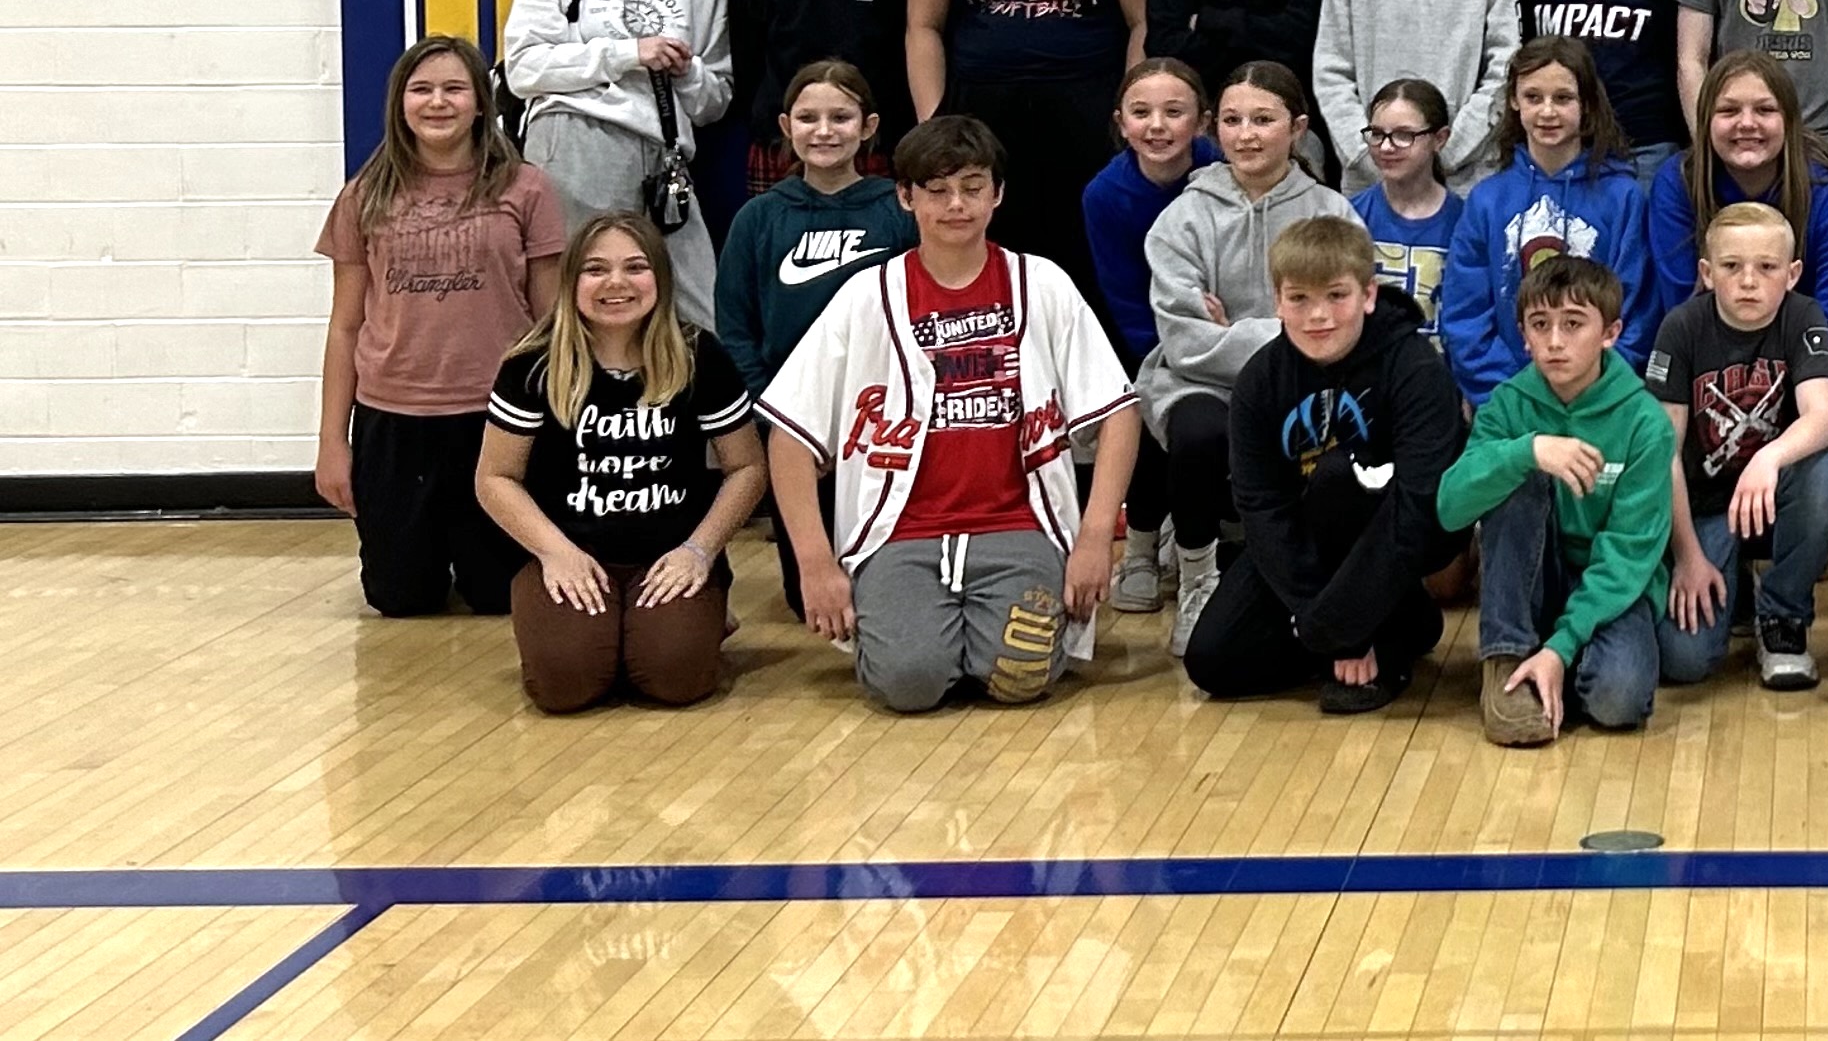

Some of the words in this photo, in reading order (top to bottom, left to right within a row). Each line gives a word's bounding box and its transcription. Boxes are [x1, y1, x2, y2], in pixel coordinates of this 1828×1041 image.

[1533, 3, 1652, 41] IMPACT
[793, 229, 867, 261] NIKE
[386, 267, 483, 302] Wrangler
[940, 312, 998, 339] UNITED
[946, 396, 999, 420] RIDE
[576, 404, 677, 448] faith
[567, 477, 687, 517] dream
